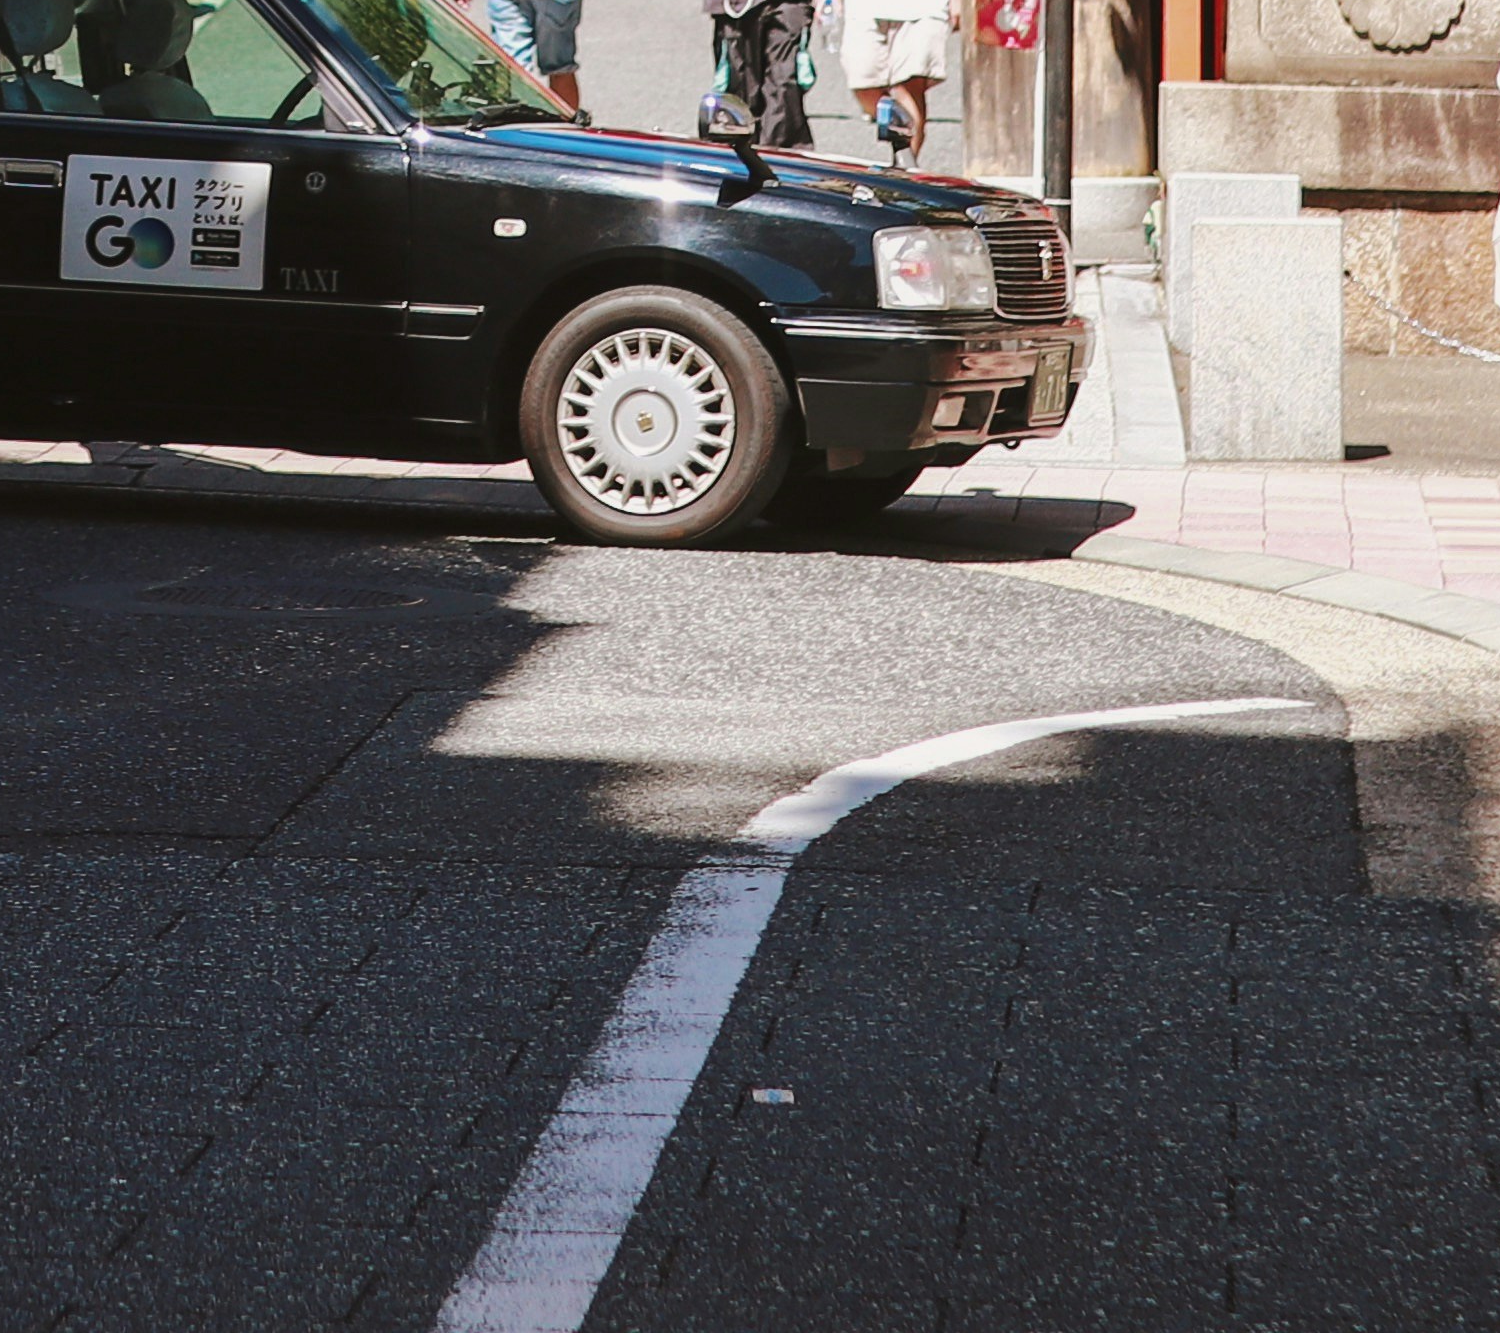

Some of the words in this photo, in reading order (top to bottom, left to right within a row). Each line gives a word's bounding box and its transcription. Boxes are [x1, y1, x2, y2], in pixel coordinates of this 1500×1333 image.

[89, 173, 177, 211] TAXI
[194, 178, 245, 193] タクシー
[193, 194, 243, 213] アプリ
[192, 212, 245, 227] といえば。
[85, 214, 175, 270] GO
[280, 267, 340, 294] TAXI
